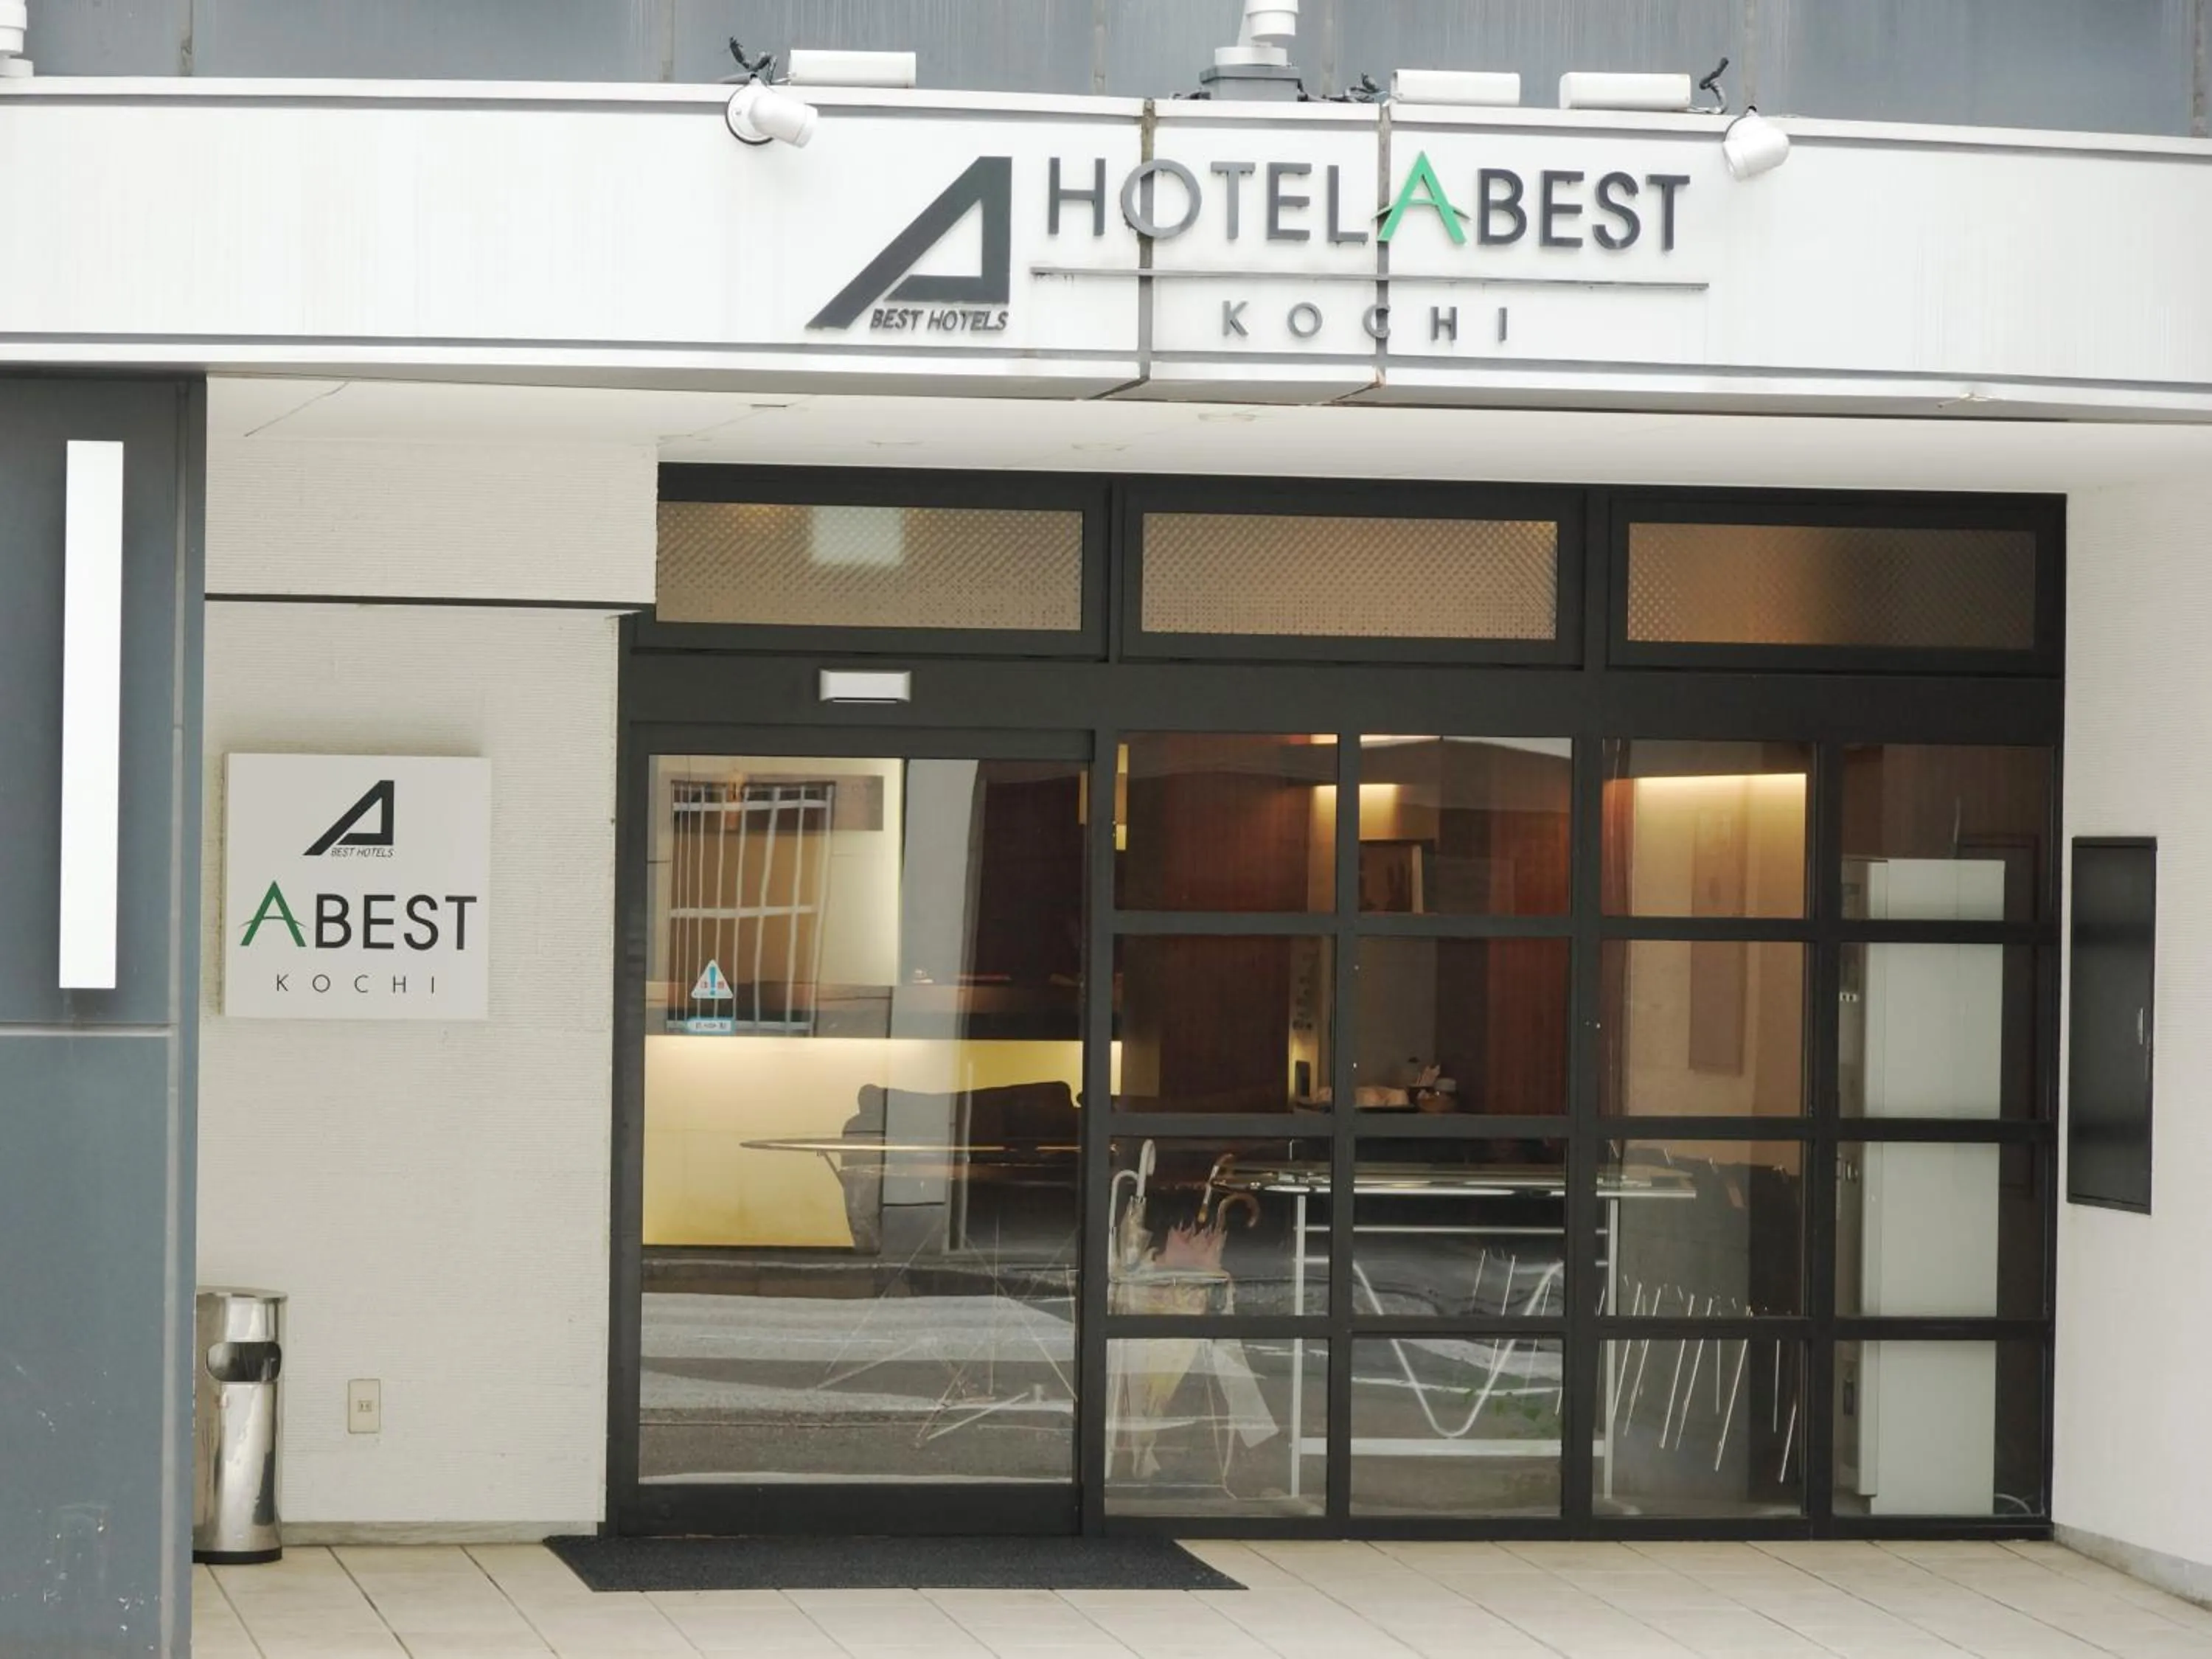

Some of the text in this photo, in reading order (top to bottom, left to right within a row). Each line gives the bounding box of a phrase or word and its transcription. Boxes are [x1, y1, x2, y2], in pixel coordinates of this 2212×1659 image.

[869, 307, 1009, 331] BEST HOTELS
[1222, 299, 1507, 342] KOCHI
[331, 847, 395, 858] BEST HOTELS
[239, 880, 478, 950] ABEST
[276, 973, 435, 995] KOCHI
